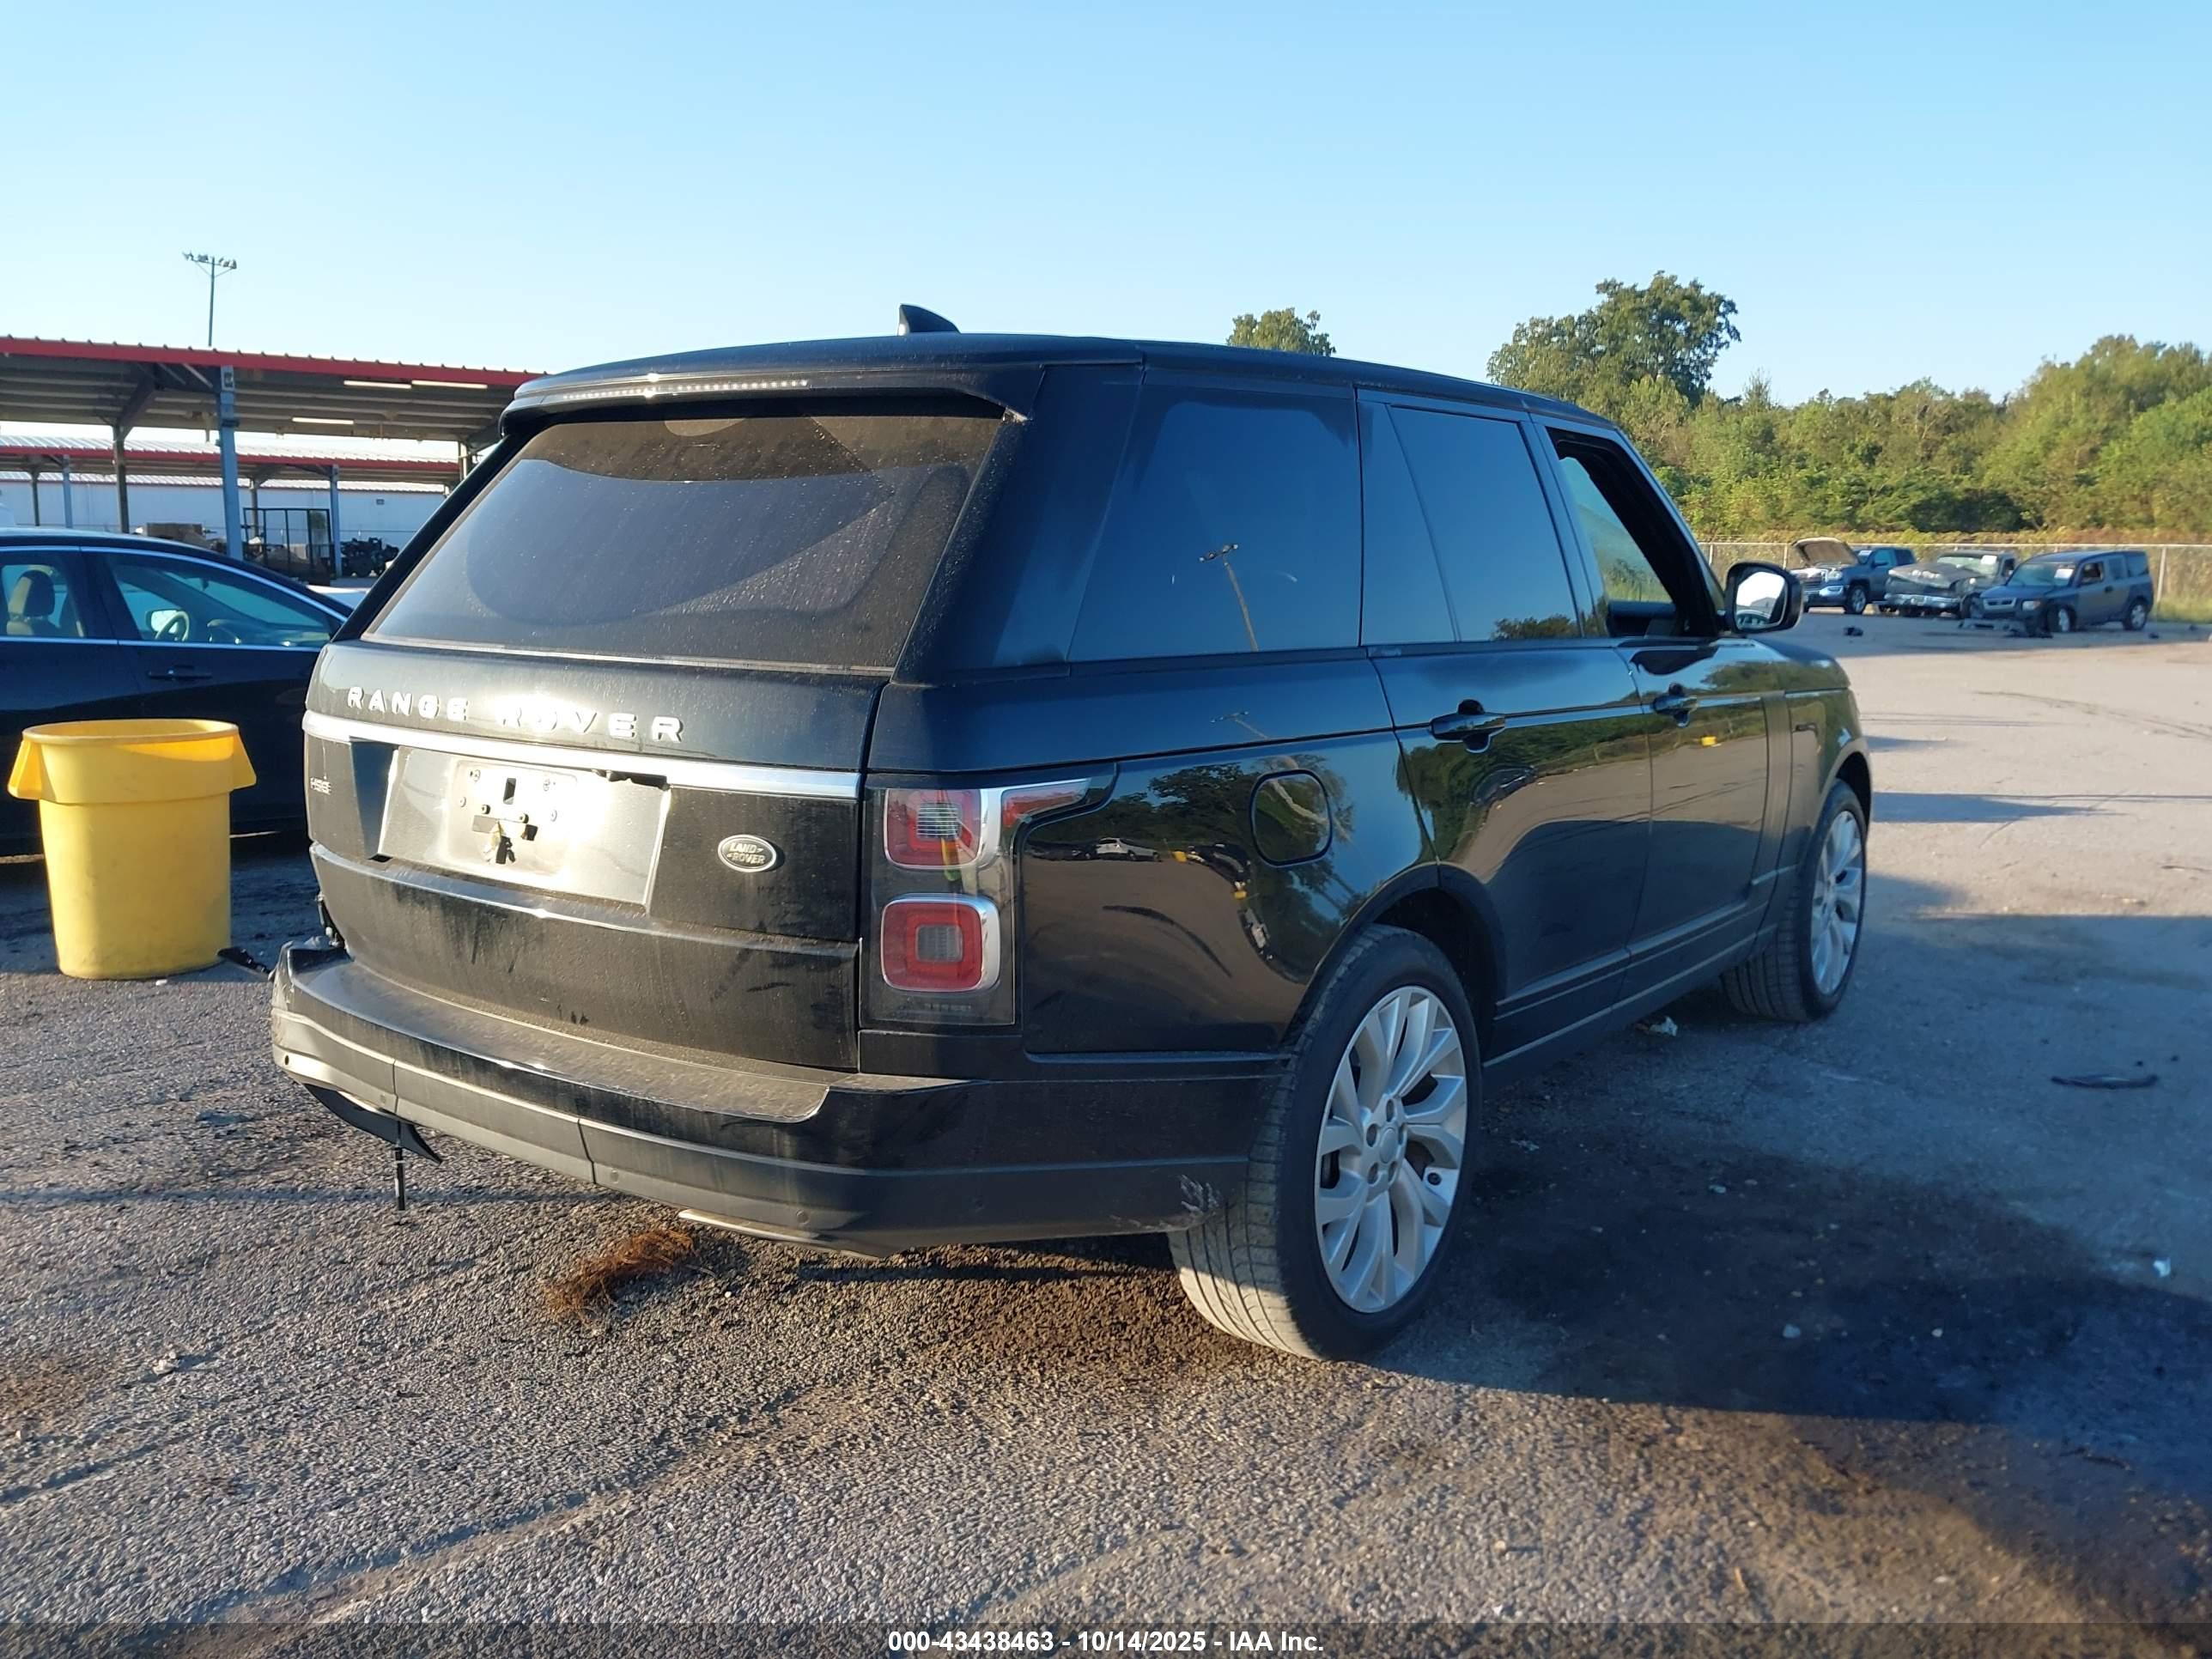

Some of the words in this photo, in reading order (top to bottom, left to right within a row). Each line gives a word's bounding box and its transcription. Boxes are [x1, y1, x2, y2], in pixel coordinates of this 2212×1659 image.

[347, 686, 469, 722] RANGE
[498, 702, 684, 742] ROVER
[729, 842, 757, 854] LAND
[732, 853, 766, 865] ROVER
